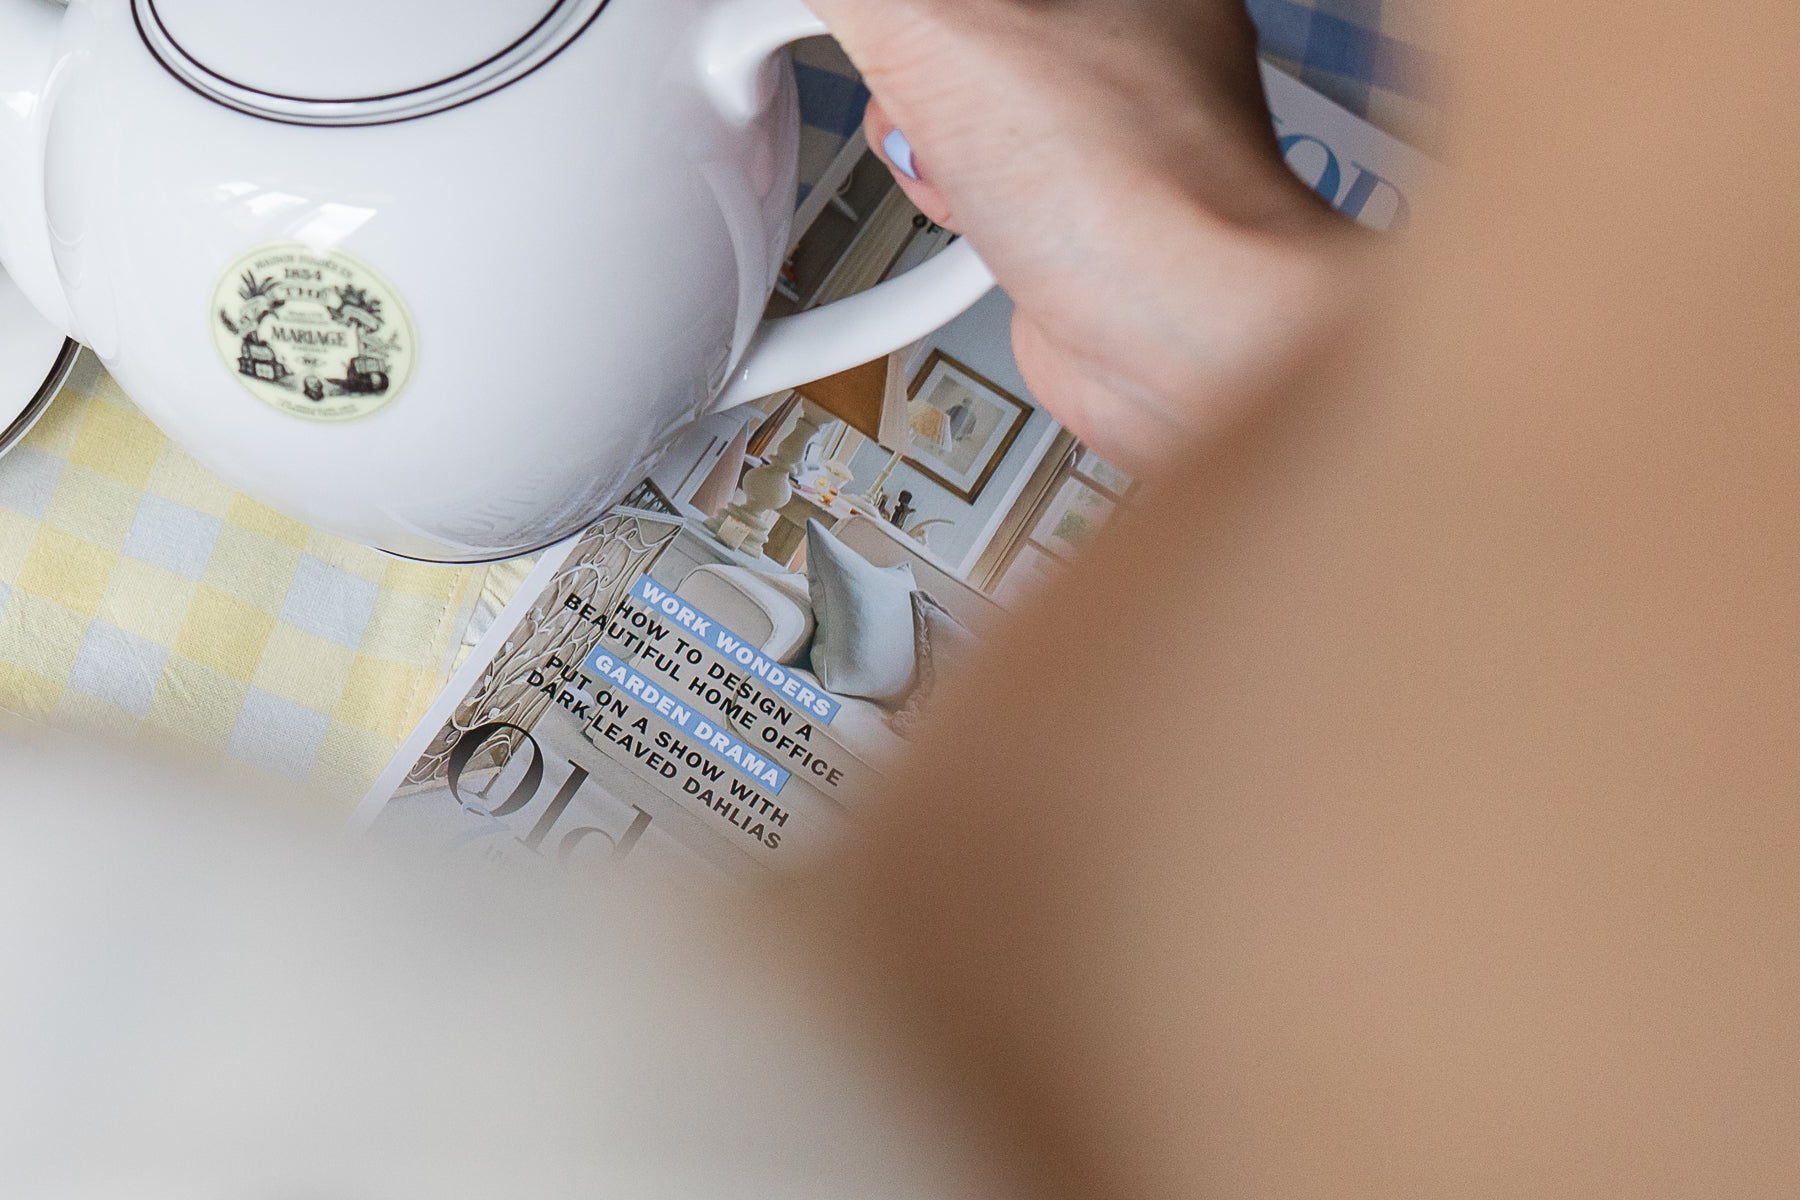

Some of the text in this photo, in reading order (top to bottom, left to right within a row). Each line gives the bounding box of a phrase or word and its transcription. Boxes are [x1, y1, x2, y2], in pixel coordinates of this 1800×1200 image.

[271, 326, 349, 347] MARIAGE
[565, 593, 844, 787] BEAUTIFUL HOME OFFICE
[614, 601, 813, 742] HOW TO DESIGN A
[642, 582, 831, 717] WORK WONDERS
[448, 721, 653, 860] Old
[526, 669, 783, 851] DARK-LEAVED DAHLIAS
[545, 655, 790, 828] PUT ON A SHOW WITH
[595, 654, 779, 788] GARDEN DRAMA
